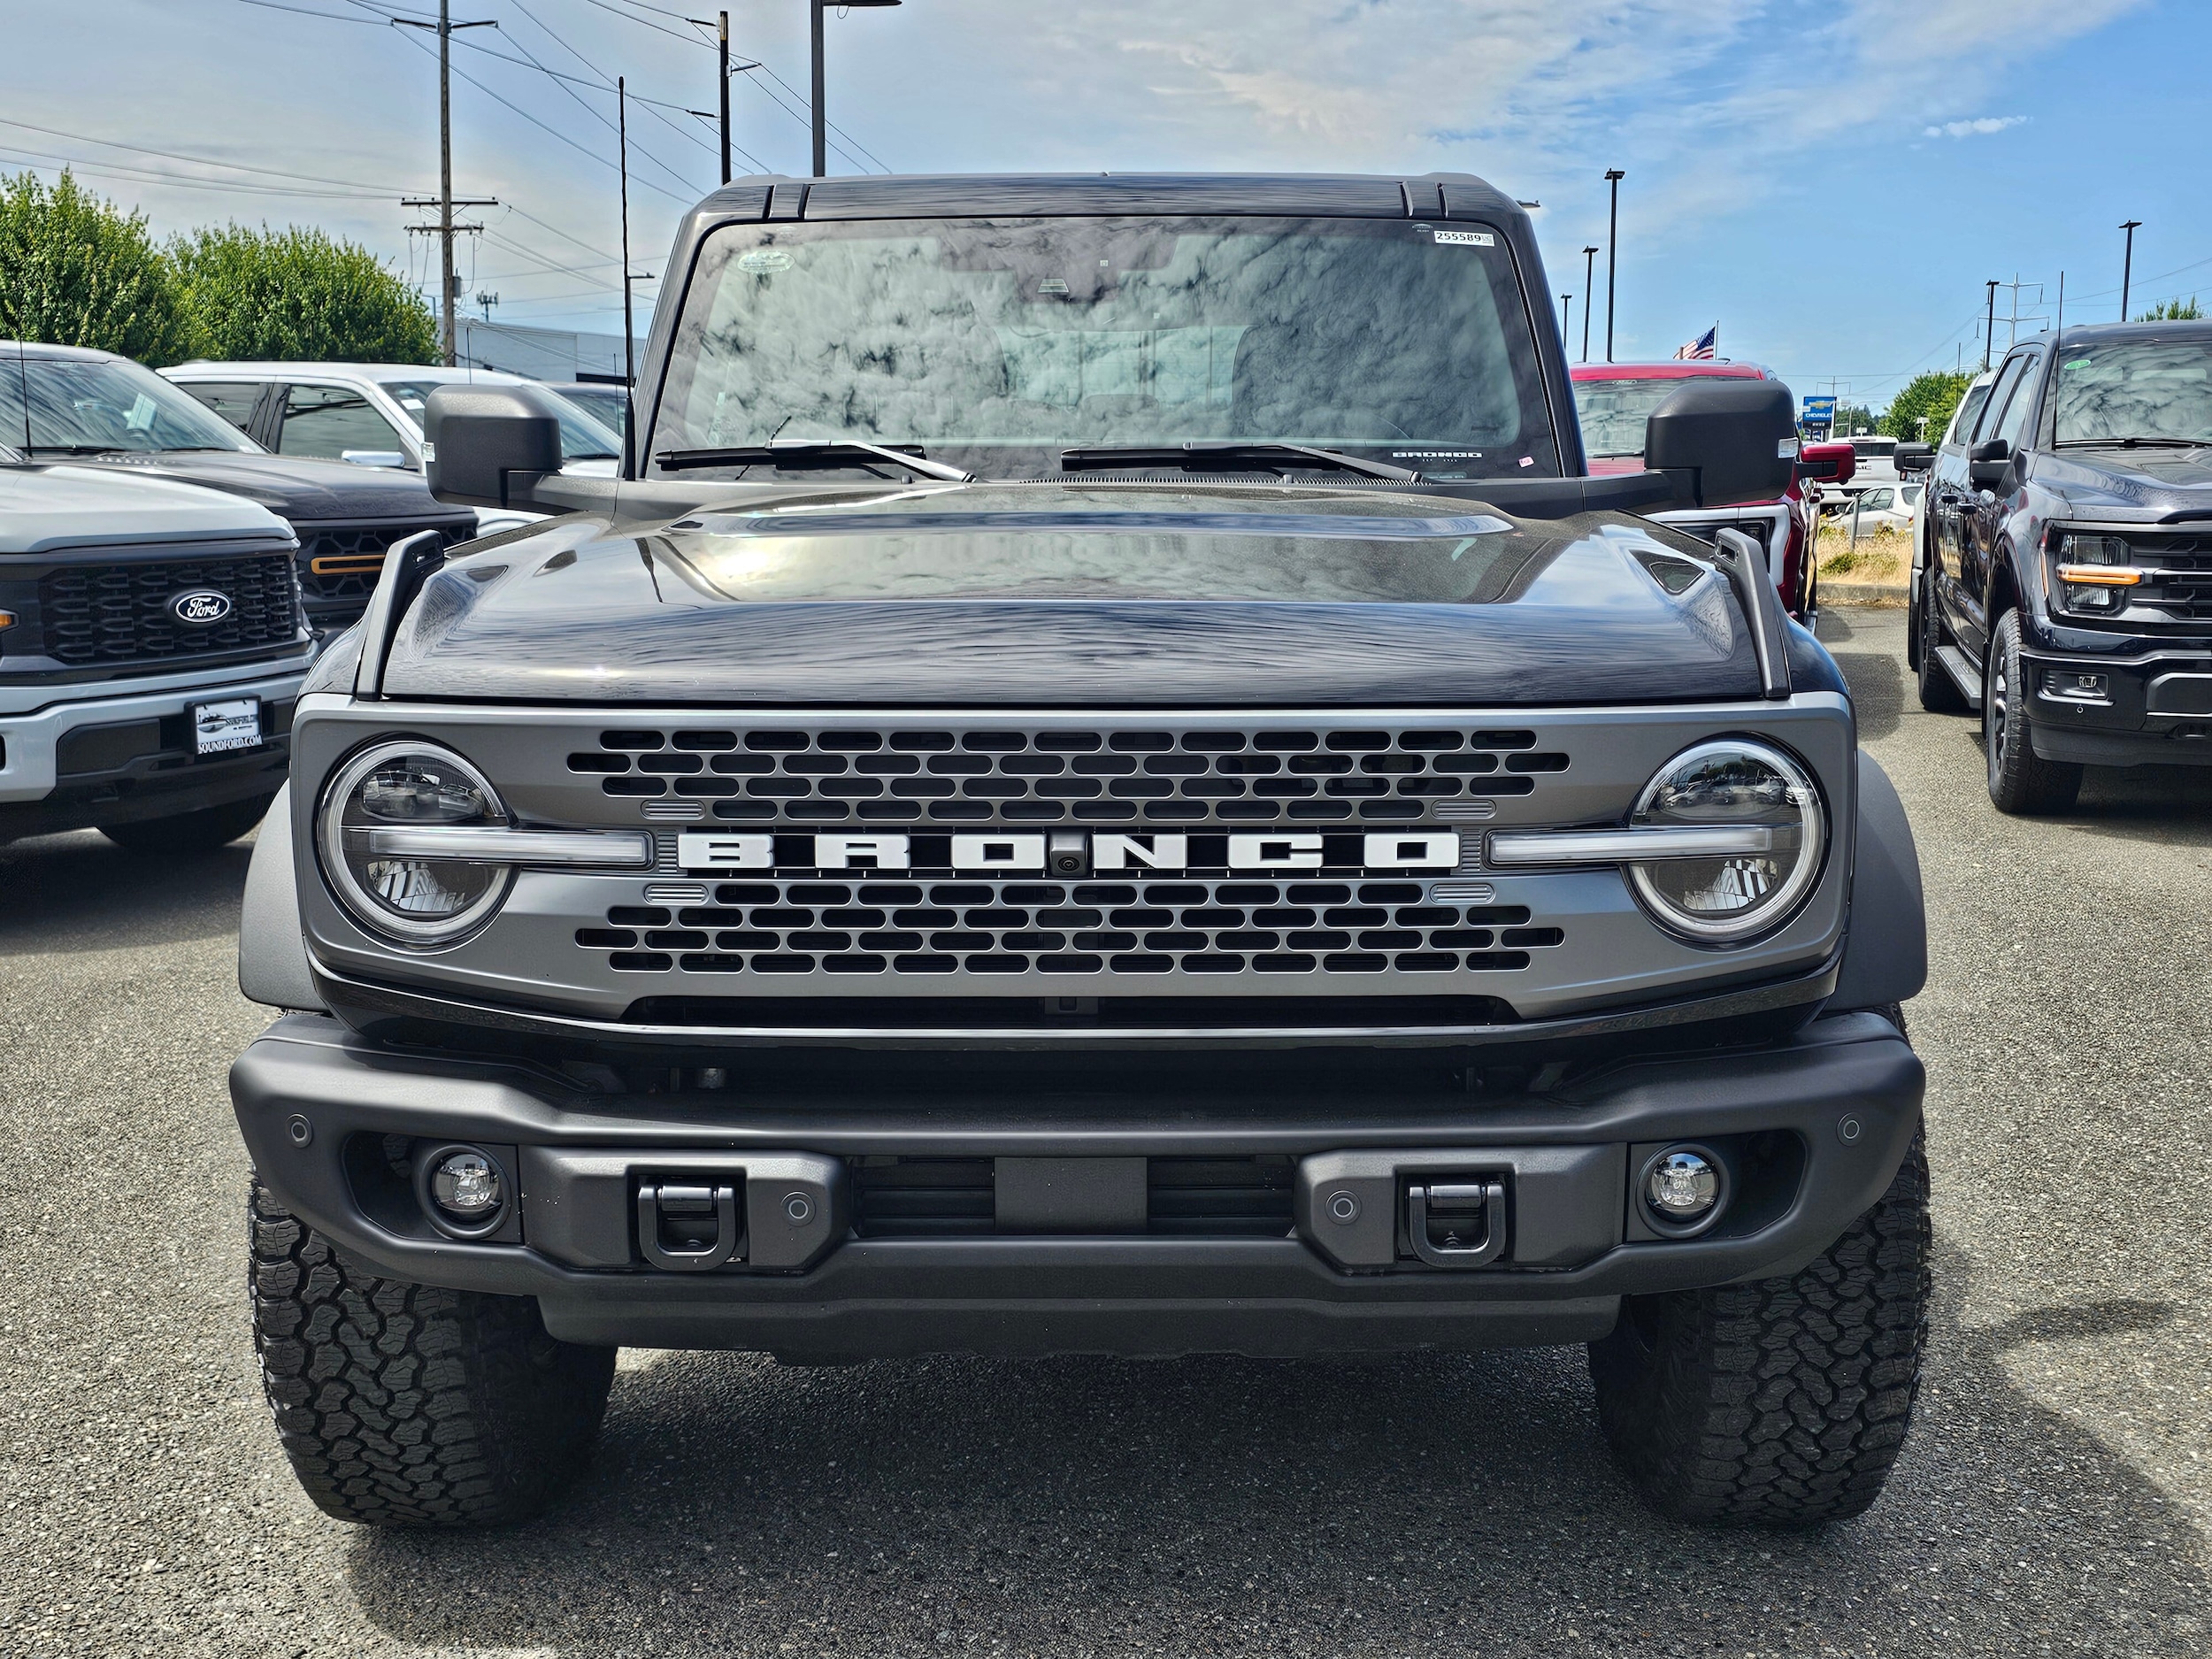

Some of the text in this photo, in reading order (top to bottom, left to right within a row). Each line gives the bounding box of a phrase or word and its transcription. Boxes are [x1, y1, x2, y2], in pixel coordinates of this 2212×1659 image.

[1436, 233, 1481, 242] 255589
[187, 597, 220, 618] Ford
[677, 833, 1460, 870] BRONCO
